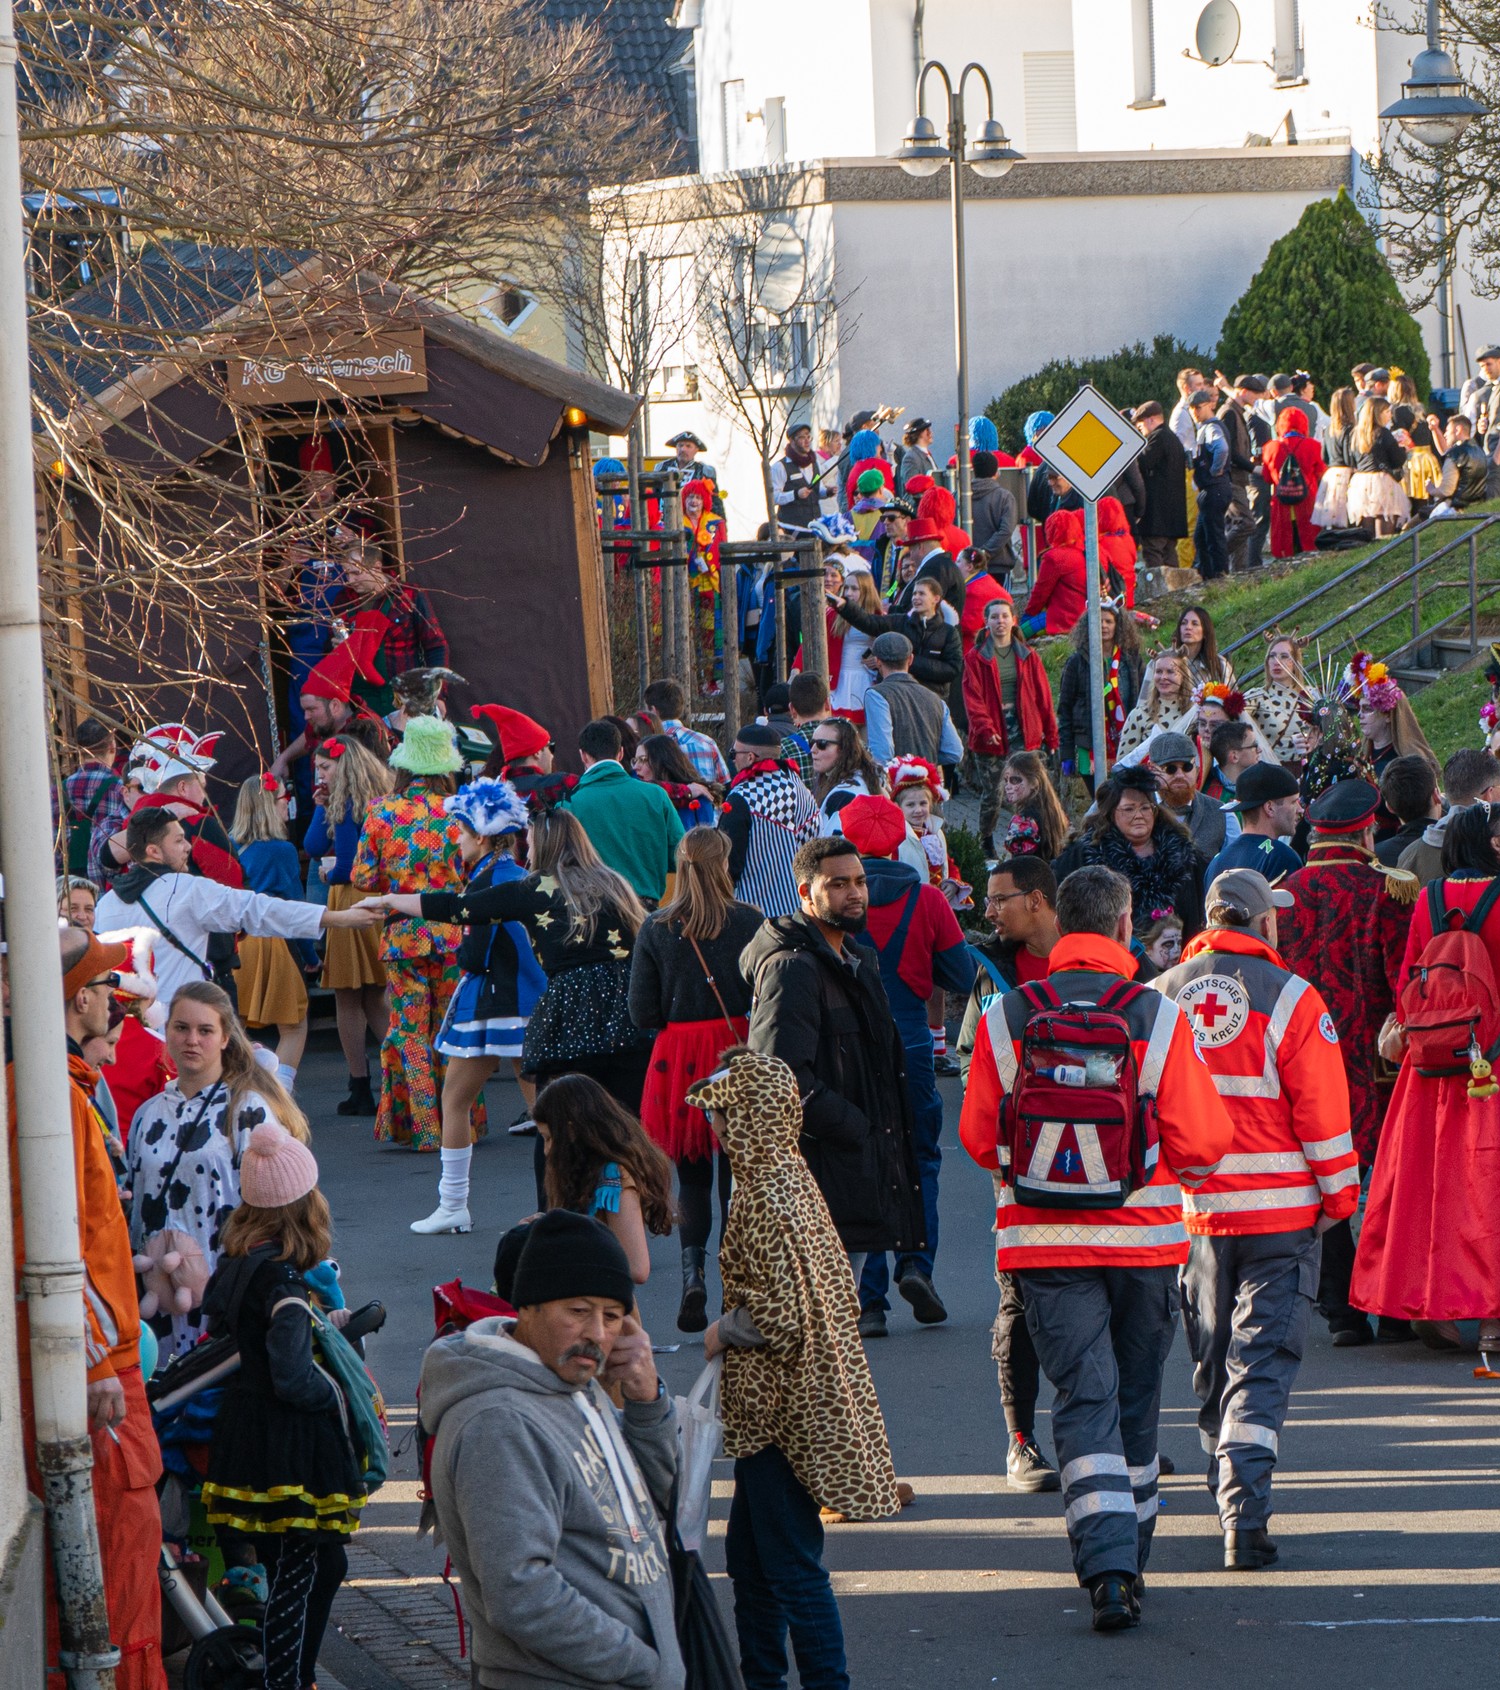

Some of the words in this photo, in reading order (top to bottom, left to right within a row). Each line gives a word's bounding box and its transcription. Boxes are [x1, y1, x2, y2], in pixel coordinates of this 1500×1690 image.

[242, 360, 286, 386] KG
[1183, 978, 1242, 1005] DEUTSCHES
[1211, 1012, 1242, 1043] KREUZ
[606, 1541, 667, 1585] TRACK
